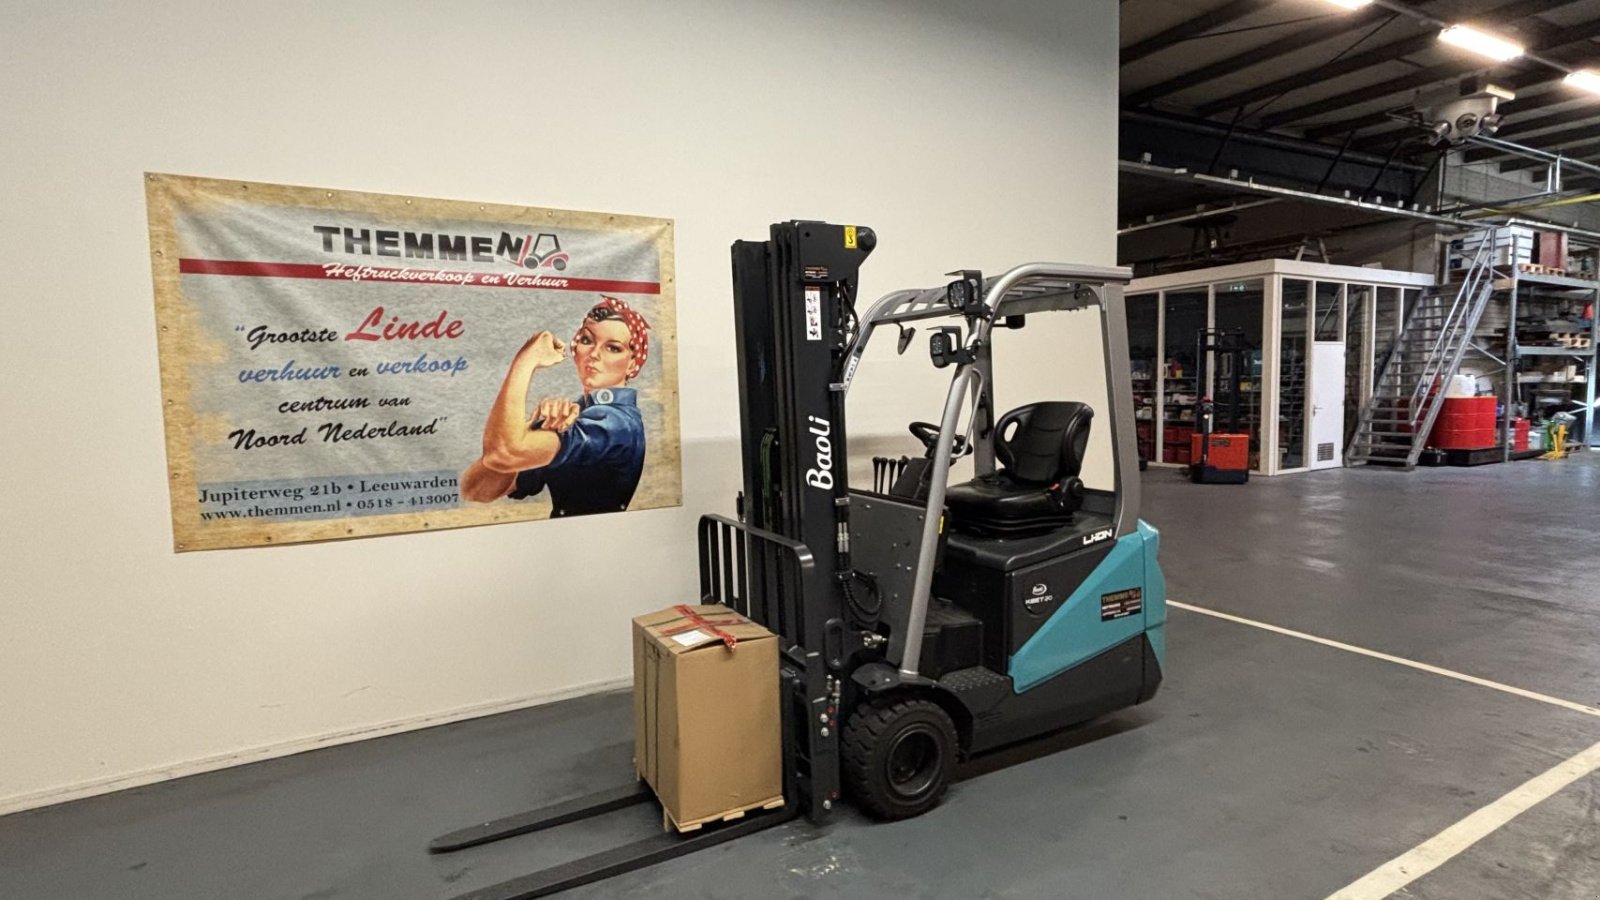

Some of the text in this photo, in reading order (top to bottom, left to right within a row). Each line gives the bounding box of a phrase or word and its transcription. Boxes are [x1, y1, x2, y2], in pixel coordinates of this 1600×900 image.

[313, 225, 523, 262] THEMMEN
[322, 262, 569, 288] Heftruckverkoop en Verhuur
[344, 306, 465, 342] Linde
[238, 353, 469, 383] verhuur en verkoop
[278, 396, 412, 414] centrum van
[228, 427, 307, 450] Noord
[806, 415, 834, 490] Baoli
[198, 476, 459, 506] Jupiterweg 21b Leeuwarden
[200, 500, 342, 521] www.themmen.nl
[356, 498, 393, 510] 0518
[409, 493, 460, 507] 413007
